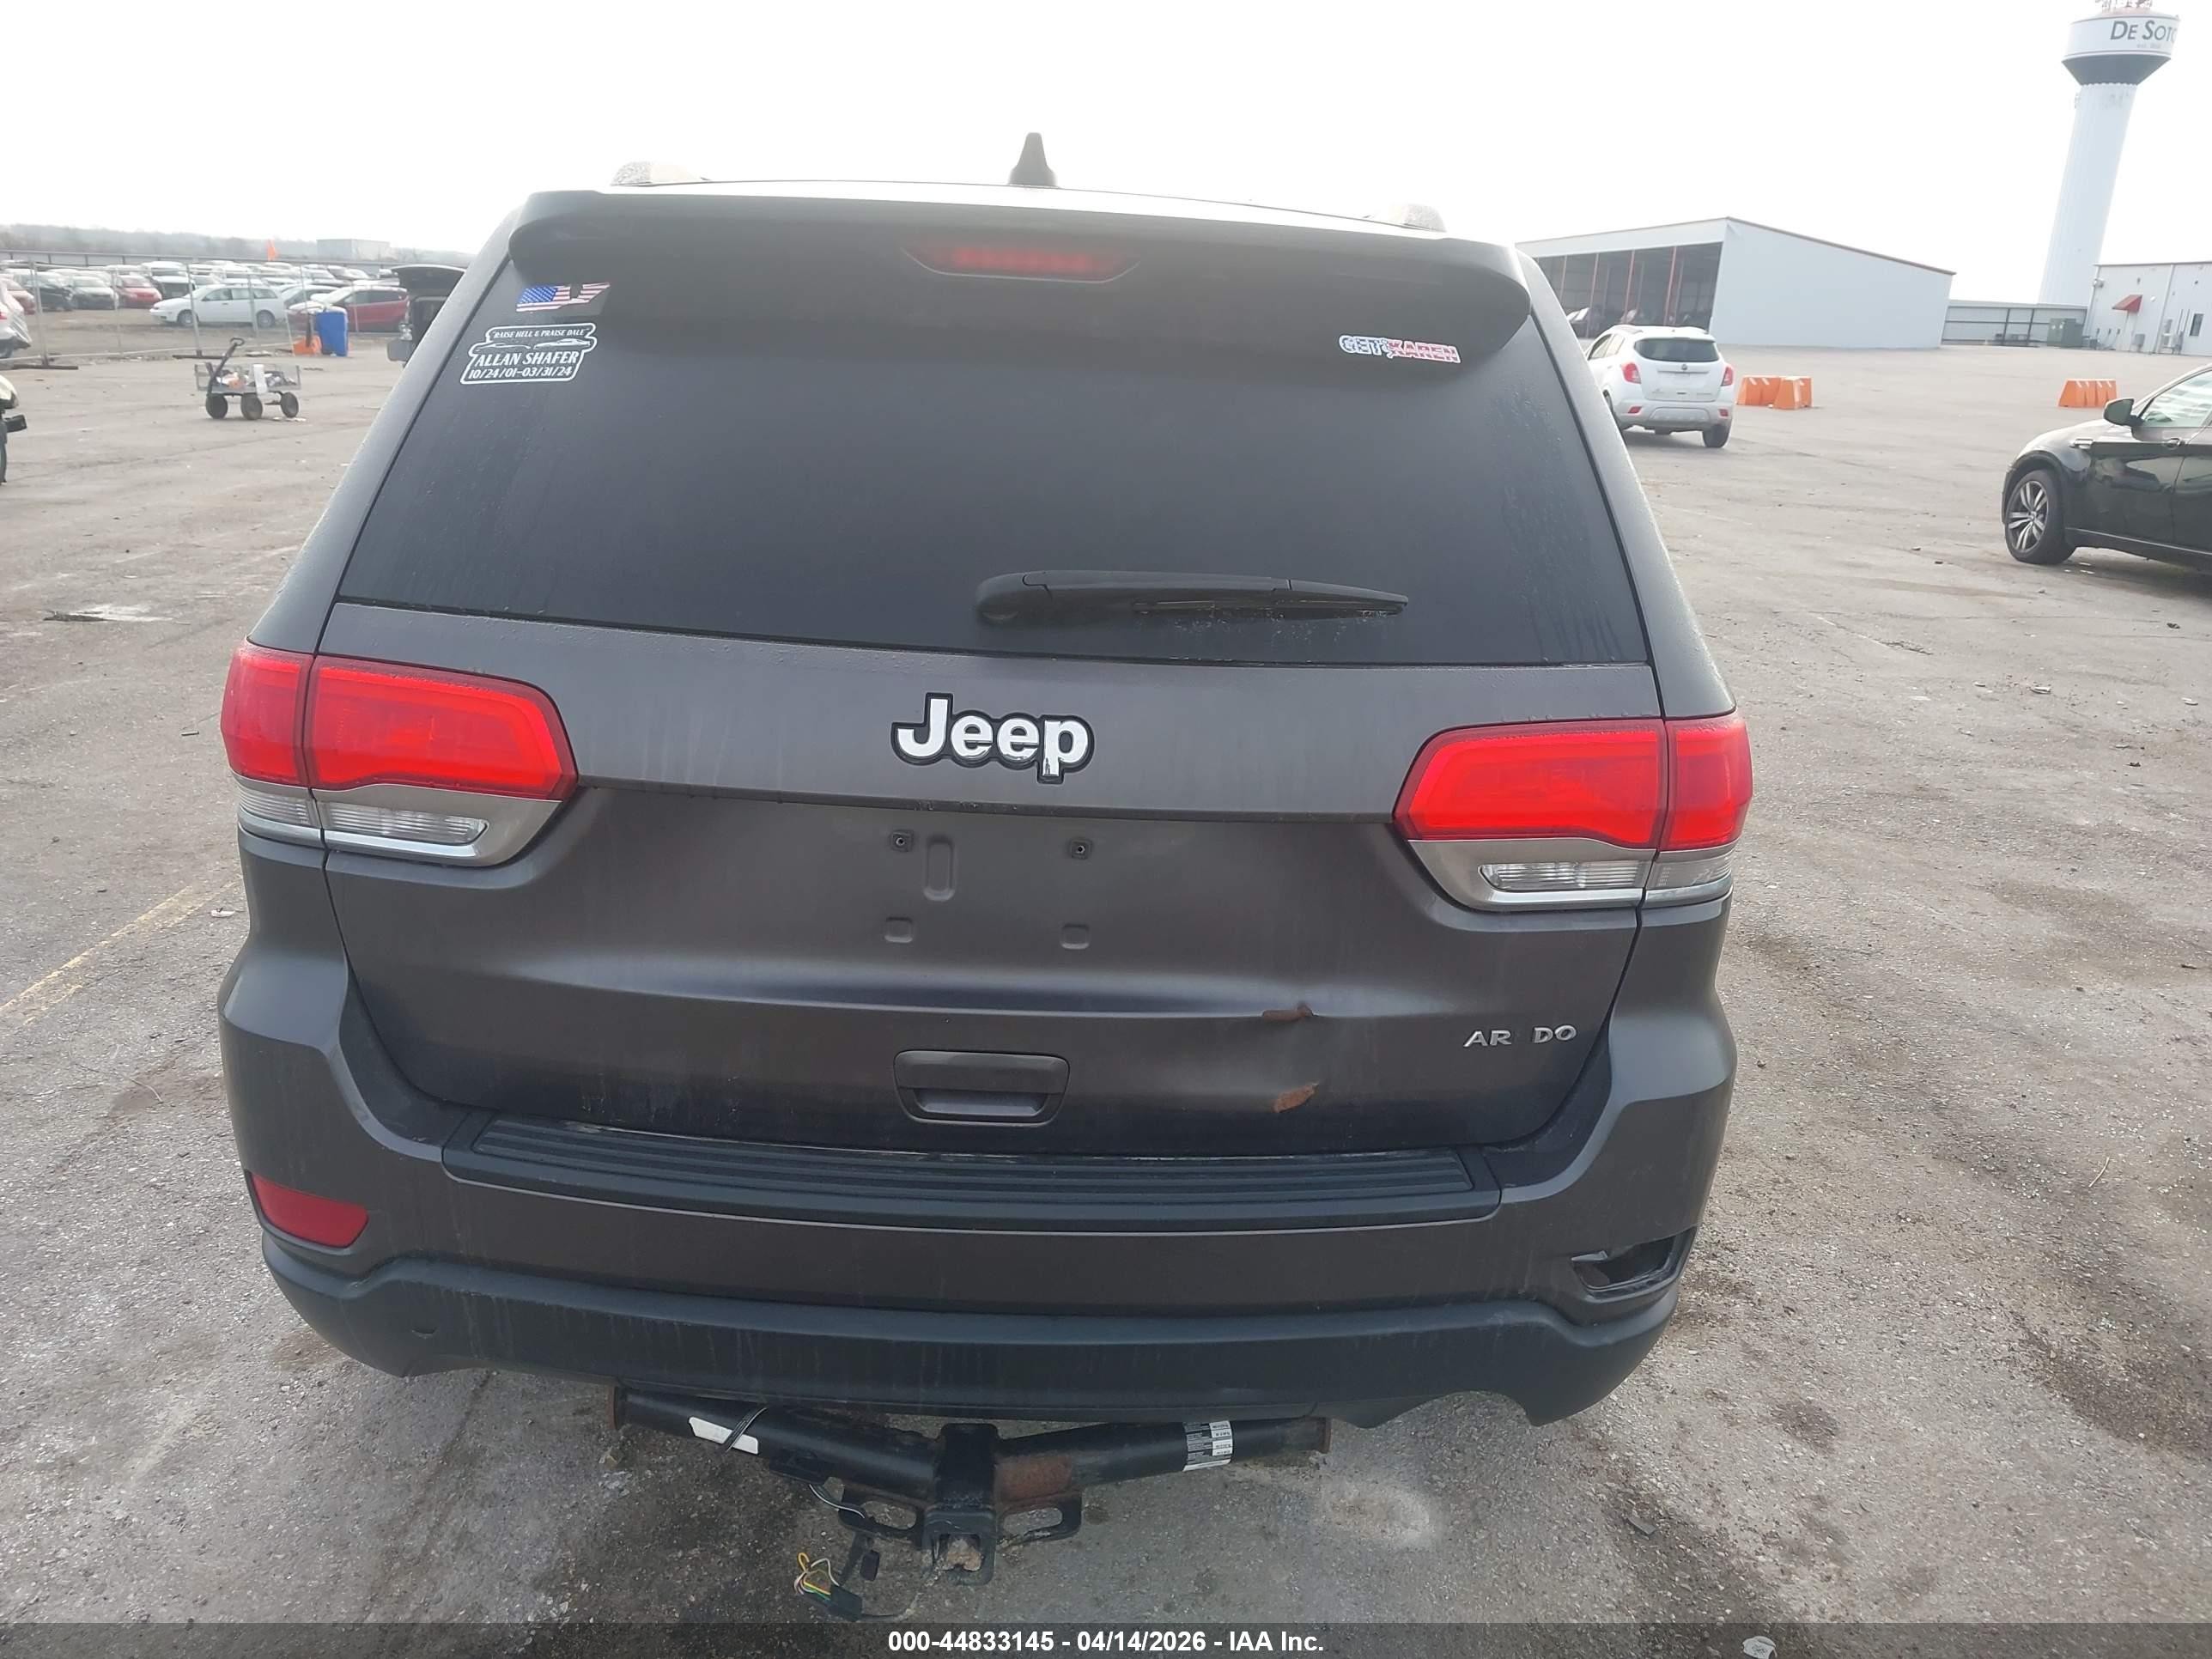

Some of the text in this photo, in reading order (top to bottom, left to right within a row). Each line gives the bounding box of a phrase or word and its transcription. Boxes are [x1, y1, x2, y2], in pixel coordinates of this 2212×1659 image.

[540, 328, 568, 337] PRAISE
[474, 350, 580, 368] ALLAN SHAFER
[894, 695, 1091, 780] Jeep
